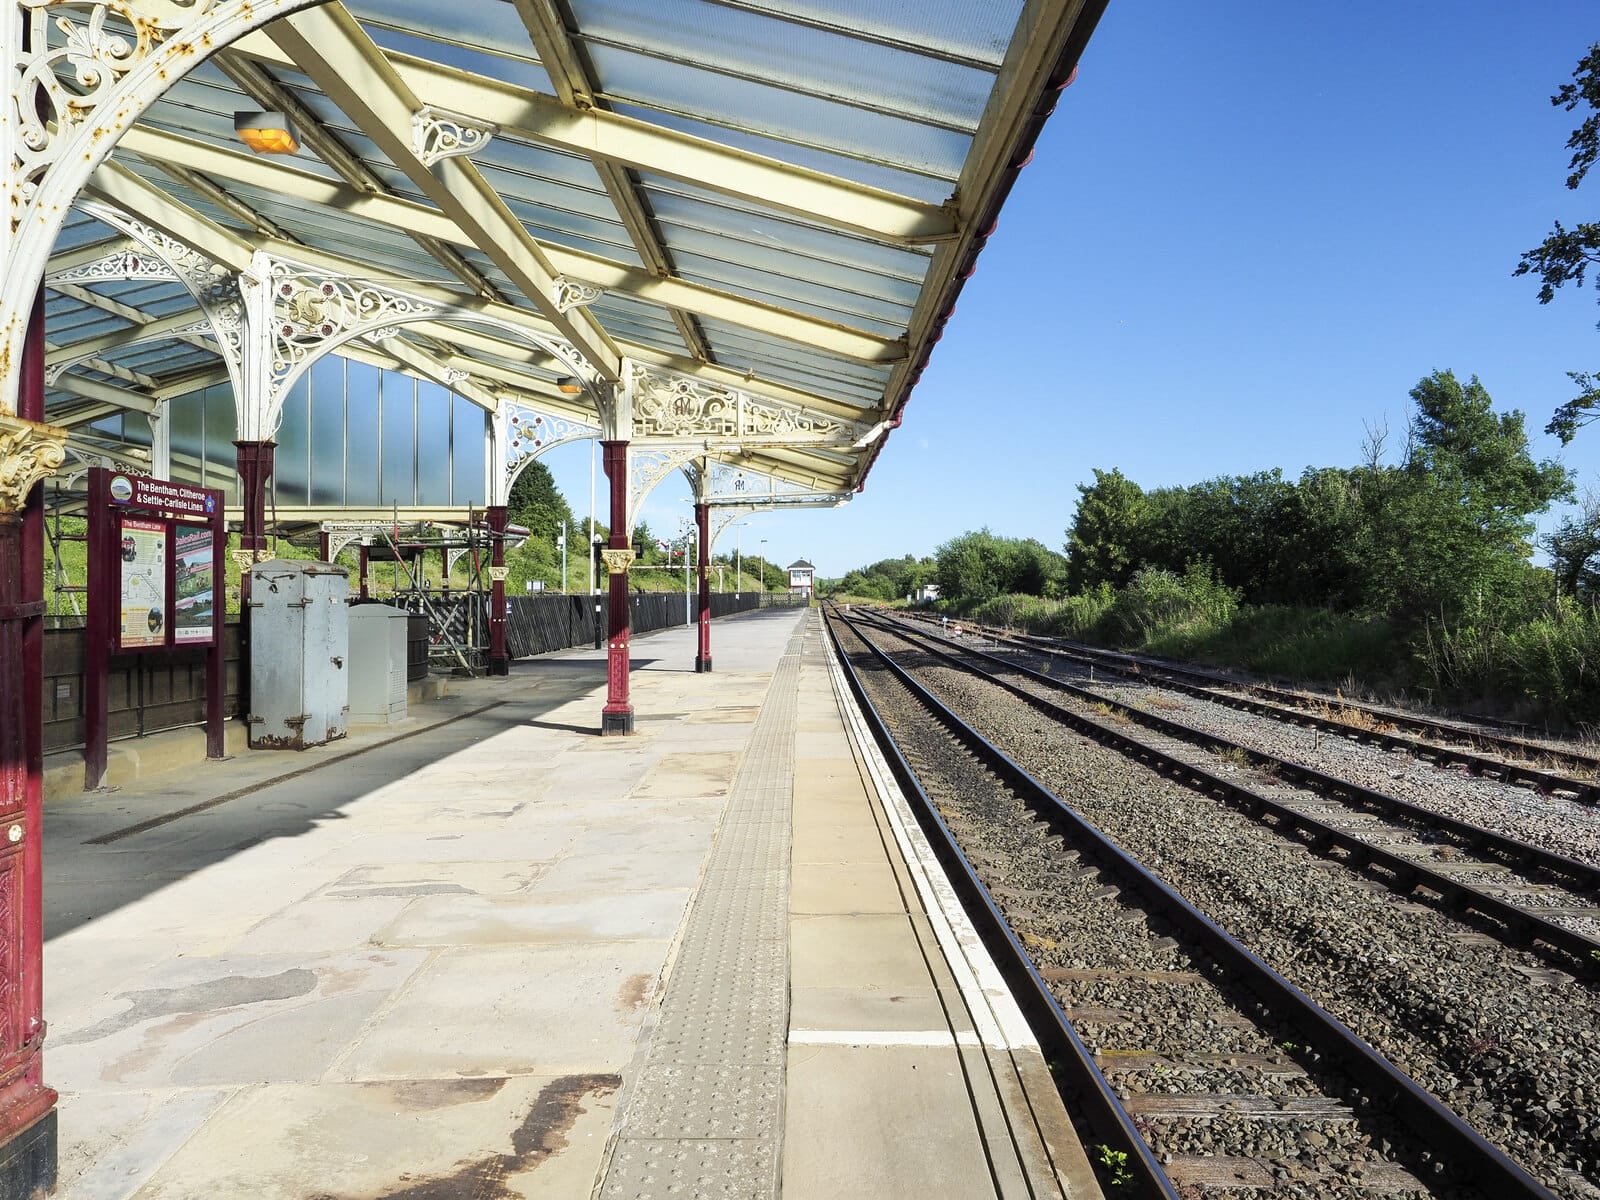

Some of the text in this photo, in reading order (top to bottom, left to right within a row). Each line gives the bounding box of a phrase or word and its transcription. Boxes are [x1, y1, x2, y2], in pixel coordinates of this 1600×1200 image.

[137, 480, 205, 501] The Bentham, Clitheroe
[137, 493, 203, 512] & Settle-Carlisle Lines
[124, 519, 132, 527] The
[132, 520, 151, 529] Bentham
